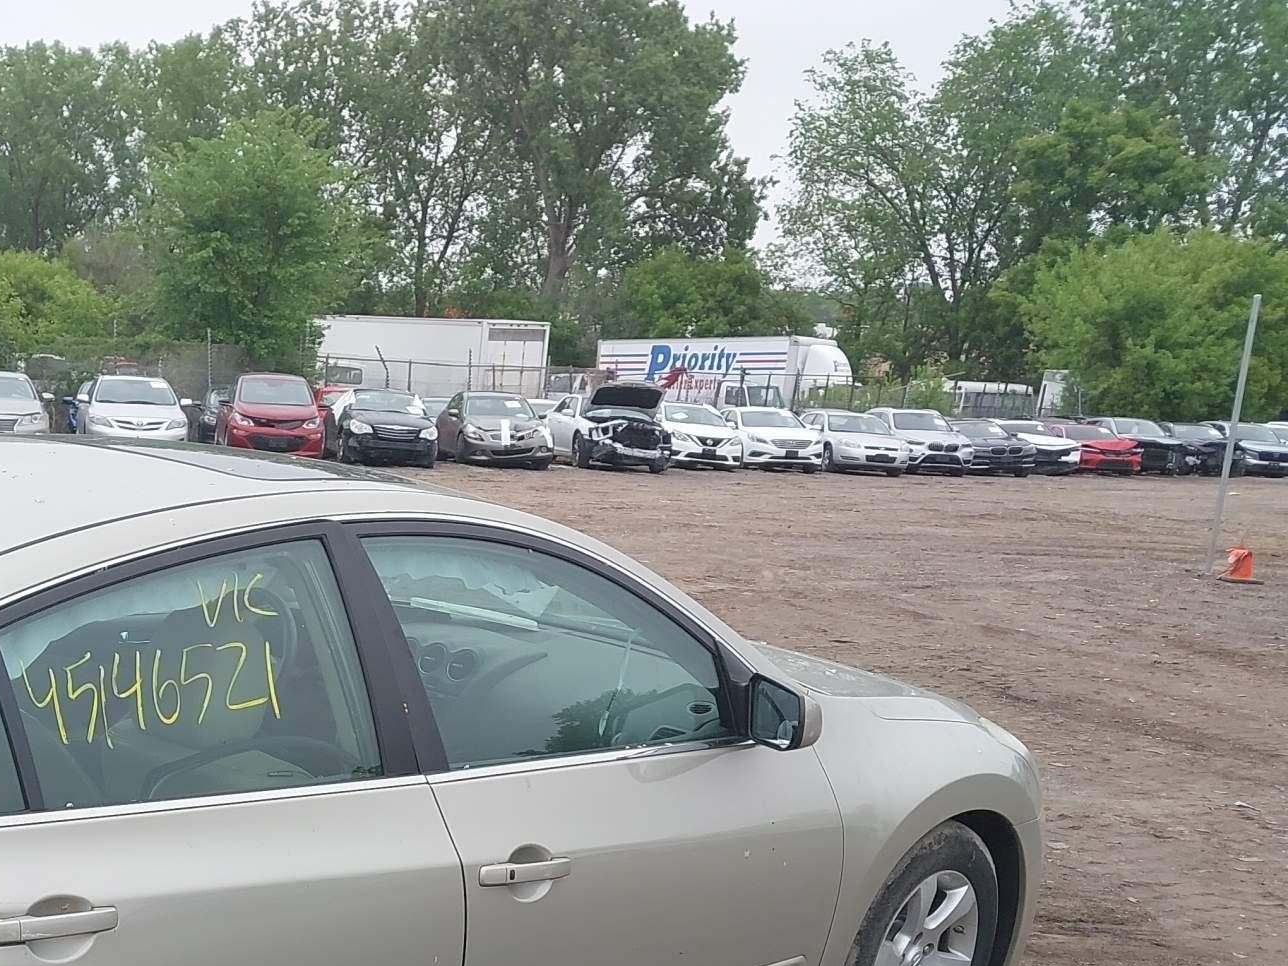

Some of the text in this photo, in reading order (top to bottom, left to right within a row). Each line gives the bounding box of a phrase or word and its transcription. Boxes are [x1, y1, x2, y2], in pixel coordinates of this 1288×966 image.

[644, 344, 737, 380] Priority
[197, 572, 279, 628] VIC
[19, 641, 281, 749] 45146521
